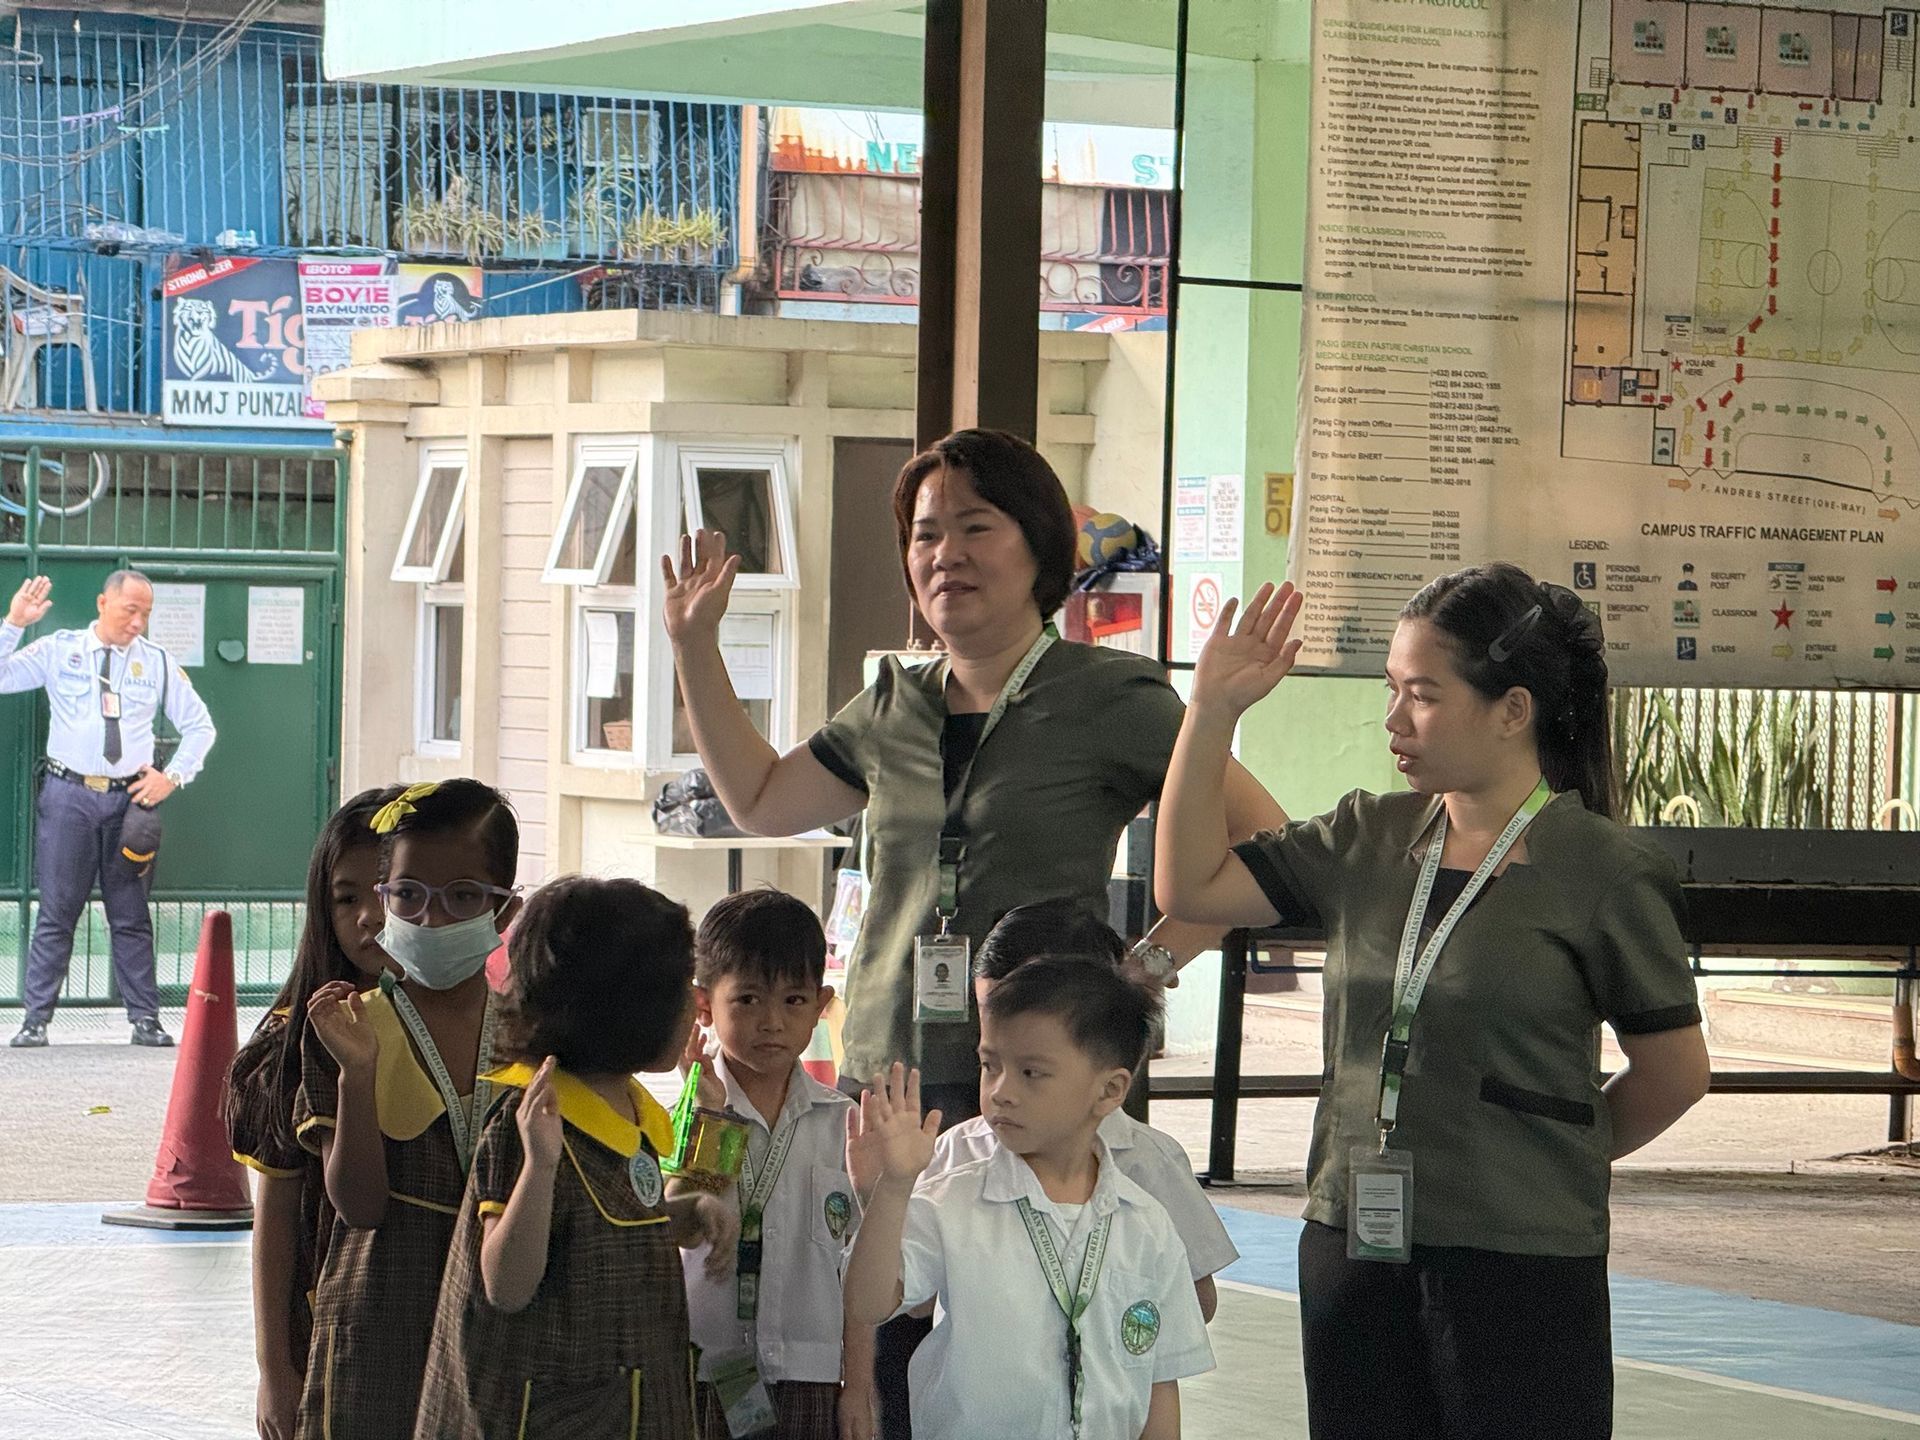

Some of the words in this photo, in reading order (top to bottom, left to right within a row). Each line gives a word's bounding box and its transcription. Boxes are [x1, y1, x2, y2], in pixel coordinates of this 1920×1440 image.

[167, 268, 208, 291] STRONG
[306, 305, 390, 314] RAYMUNDO
[373, 316, 390, 326] 15
[1341, 341, 1369, 350] GREEN
[1685, 359, 1700, 367] YOU
[1701, 360, 1716, 368] ARE
[1685, 368, 1703, 376] HERE
[171, 389, 228, 416] MMJ
[1310, 494, 1345, 503] HOSPITAL
[1714, 486, 1762, 499] ANDRES
[1767, 492, 1810, 506] STREET
[1641, 523, 1696, 537] CAMPUS
[1699, 525, 1756, 539] TRAFFIC
[1760, 527, 1847, 542] MANAGEMENT
[1850, 530, 1884, 543] PLAN
[1569, 541, 1610, 550] LEGEND:
[1606, 565, 1640, 573] PERSONS
[1346, 572, 1392, 581] EMERGENCY
[1605, 575, 1624, 583] WITH
[1625, 576, 1662, 584] DISABILITY
[1711, 573, 1746, 581] SECURITY
[1605, 584, 1634, 592] ACCESS
[1710, 582, 1730, 590] POST
[1607, 604, 1650, 613] EMERGENCY
[1712, 608, 1757, 617] CLASSROOM
[1607, 613, 1621, 621] EXIT
[1607, 642, 1630, 650] TOILET
[1712, 645, 1735, 653] STAIRS
[1407, 968, 1422, 998] PASIG
[1420, 931, 1441, 966] GREEN
[1438, 895, 1467, 935] PASTURE
[1463, 849, 1499, 898] CHRISTIAN
[1495, 816, 1524, 850] SCHOOL
[1037, 1228, 1056, 1267] SCHOOL
[1081, 1261, 1093, 1289] PASIG
